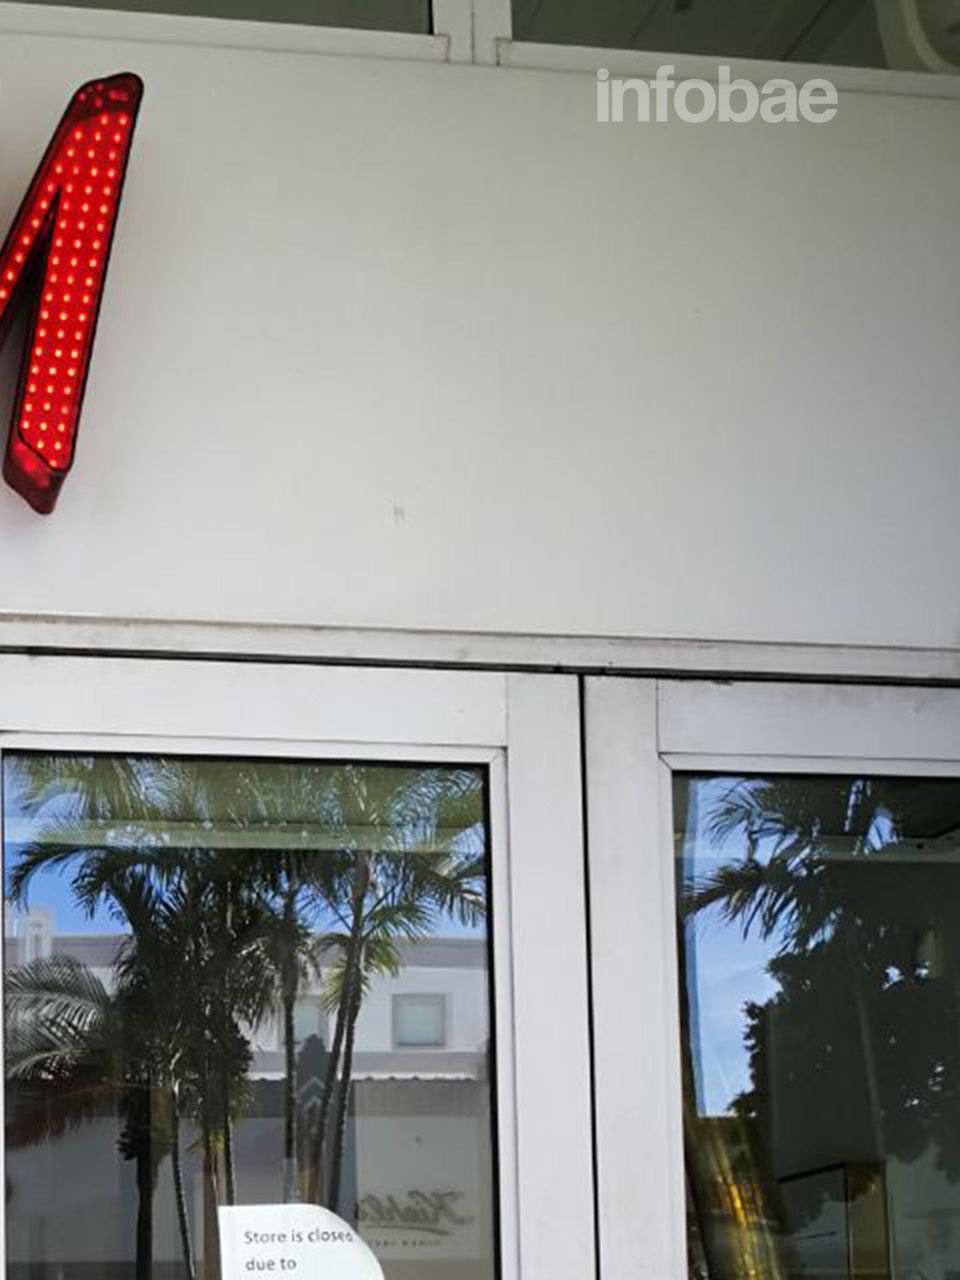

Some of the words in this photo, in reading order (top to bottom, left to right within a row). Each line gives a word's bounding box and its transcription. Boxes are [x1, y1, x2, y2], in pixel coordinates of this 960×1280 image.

[244, 1230, 287, 1245] Store
[291, 1229, 304, 1243] is
[245, 1257, 276, 1271] due
[280, 1258, 298, 1270] to
